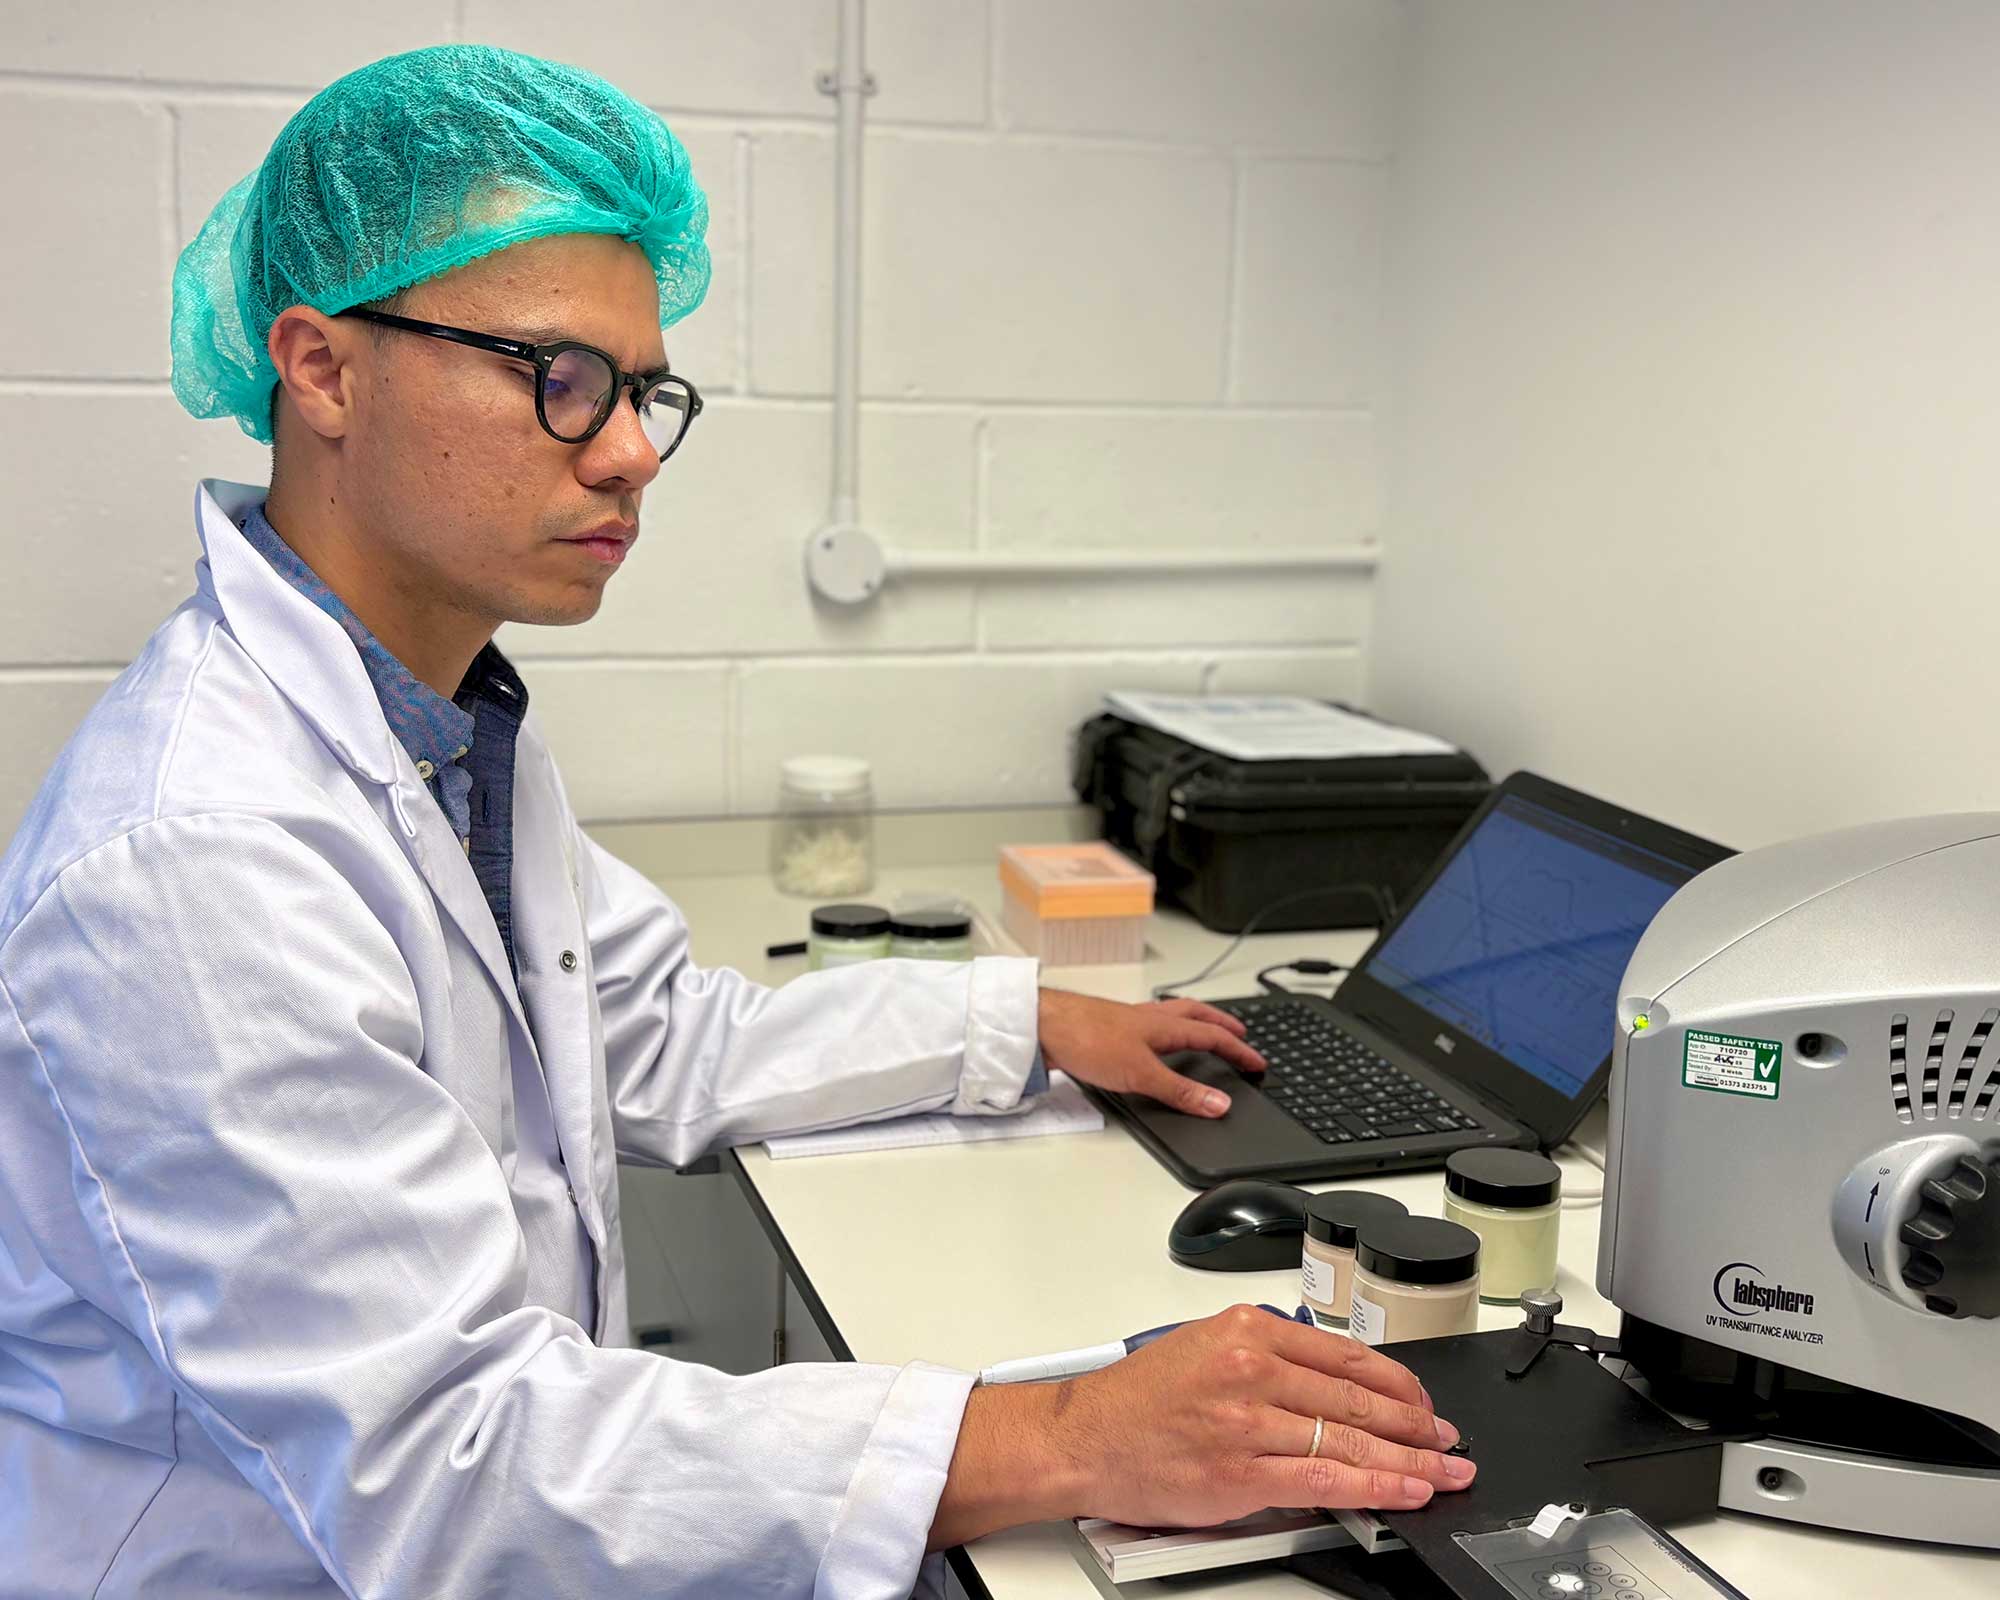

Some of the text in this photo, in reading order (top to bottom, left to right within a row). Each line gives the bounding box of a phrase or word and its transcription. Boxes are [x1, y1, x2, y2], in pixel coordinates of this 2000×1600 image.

[1688, 1032, 1780, 1051] PASSED SAFETY TEST
[1689, 1052, 1698, 1060] Test
[1878, 1167, 1891, 1176] UP
[1733, 1277, 1815, 1315] labsphere
[1706, 1314, 1824, 1344] UV TRANSMITTANCE ANALYZER
